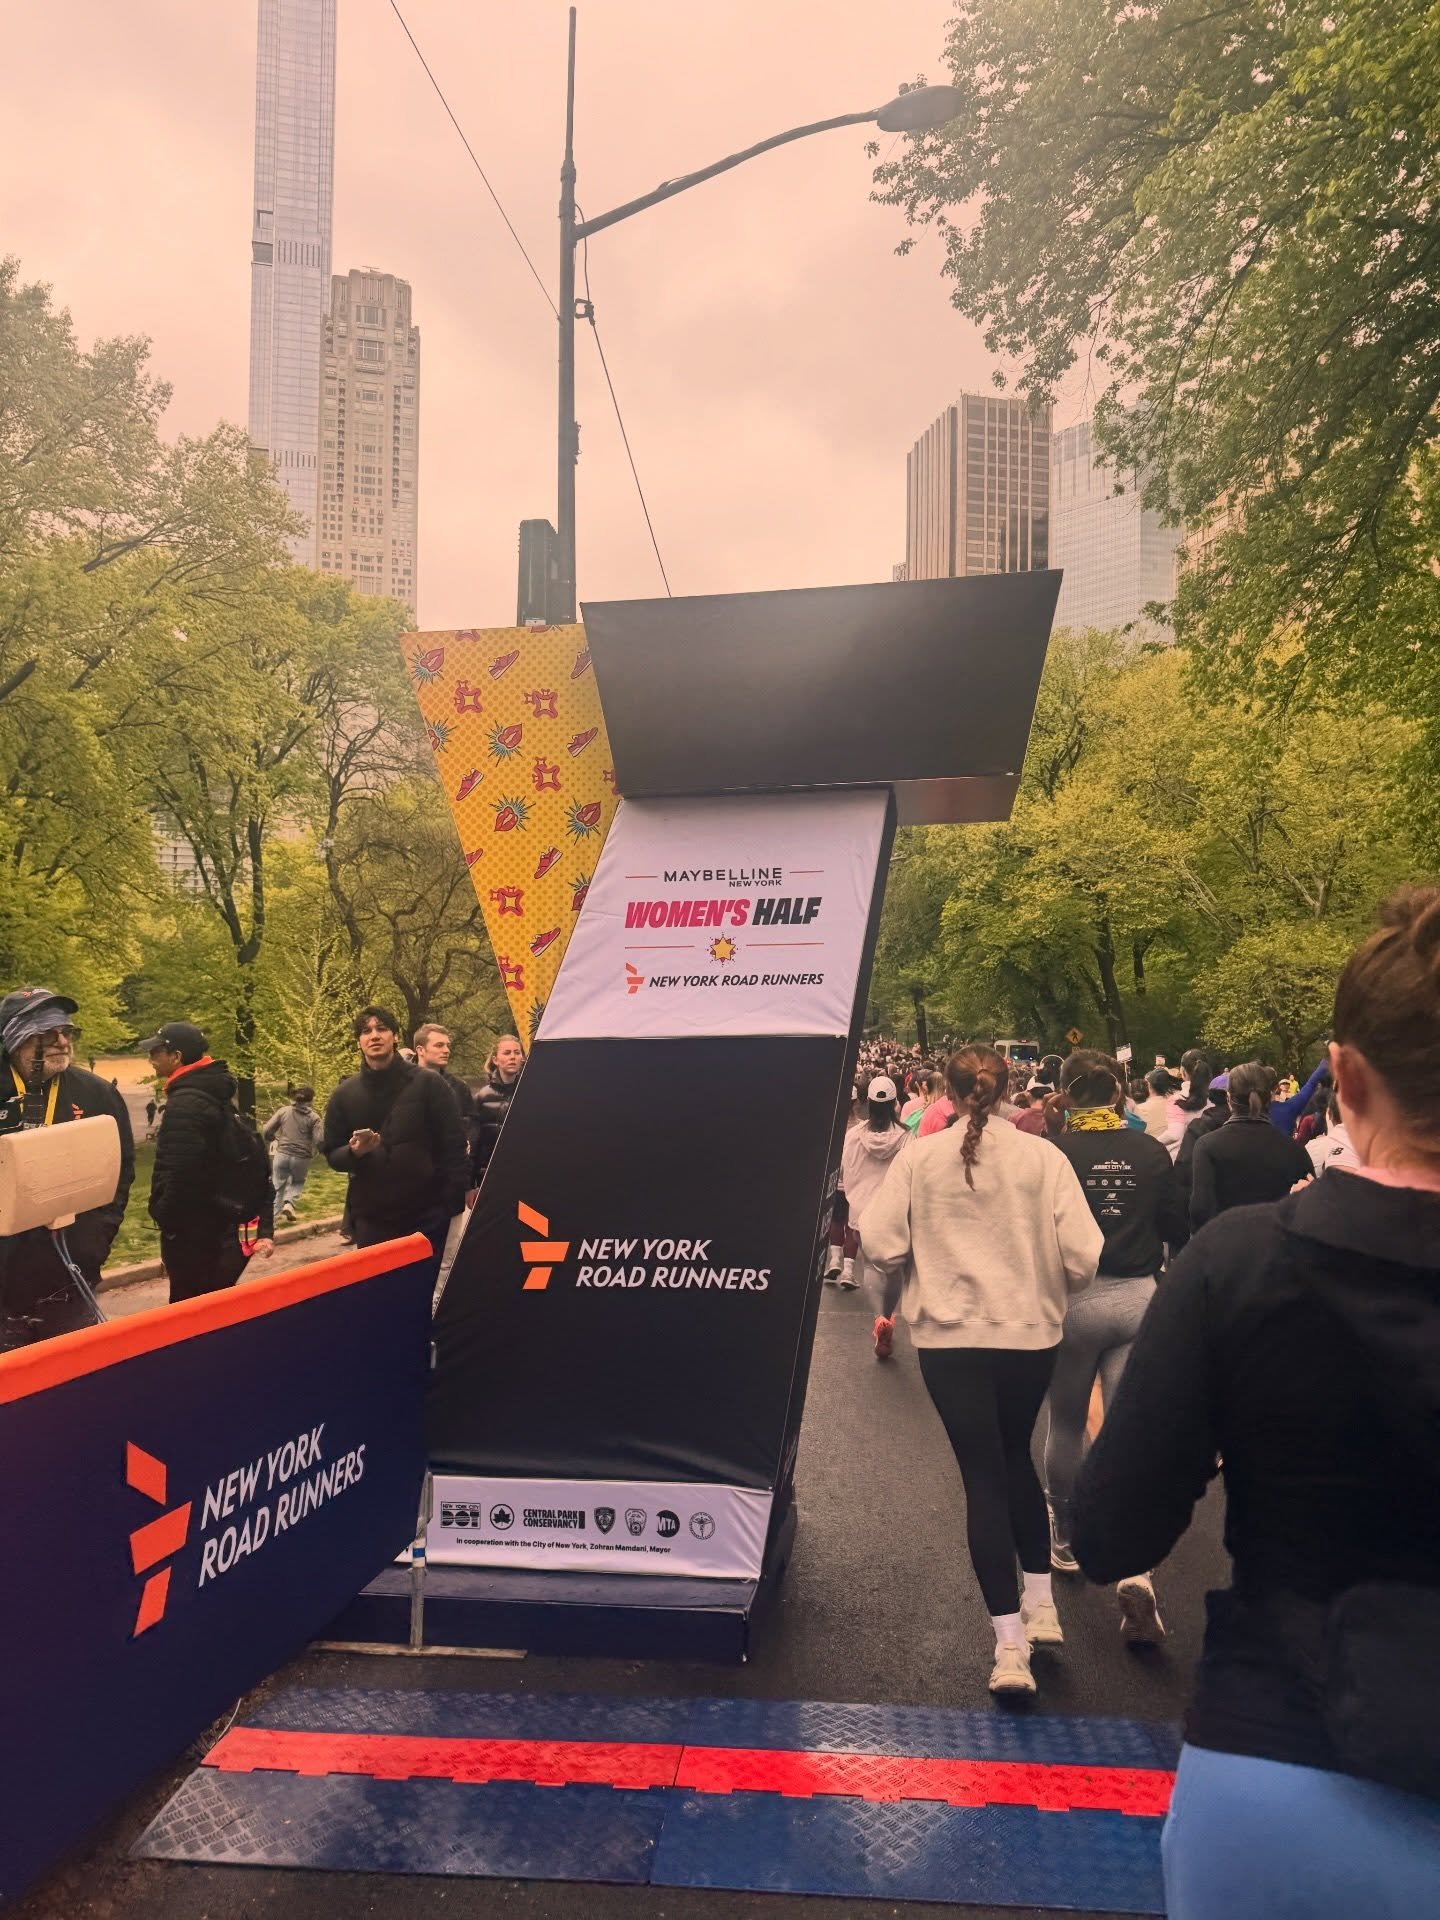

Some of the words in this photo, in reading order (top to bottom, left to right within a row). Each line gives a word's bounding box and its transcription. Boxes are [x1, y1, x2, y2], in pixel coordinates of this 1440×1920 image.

[664, 867, 783, 882] MAYBELLINE
[729, 880, 752, 888] NEW
[754, 879, 782, 887] YORK
[624, 899, 750, 929] WOMEN'S
[752, 896, 822, 926] HALF
[649, 976, 681, 988] NEW
[683, 975, 718, 987] YORK
[721, 974, 759, 986] ROAD
[761, 973, 824, 986] RUNNERS
[577, 1238, 638, 1261] NEW
[643, 1238, 713, 1261] YORK
[575, 1266, 646, 1288] ROAD
[650, 1267, 771, 1291] RUNNERS
[200, 1457, 263, 1531] NEW
[266, 1422, 325, 1491] YORK
[198, 1505, 270, 1588] ROAD
[273, 1443, 366, 1537] RUNNERS
[442, 1510, 480, 1528] DOT
[523, 1508, 557, 1519] CENTRAL
[557, 1510, 578, 1520] PARK
[523, 1518, 578, 1529] CONSERVANCY
[657, 1516, 676, 1531] MTA
[464, 1538, 504, 1547] cooperation
[504, 1539, 520, 1547] with
[520, 1540, 531, 1548] the
[532, 1541, 546, 1549] City
[571, 1542, 589, 1550] York,
[590, 1543, 614, 1551] Zohran
[615, 1544, 649, 1553] Mamdani,
[649, 1546, 671, 1554] Mayor
